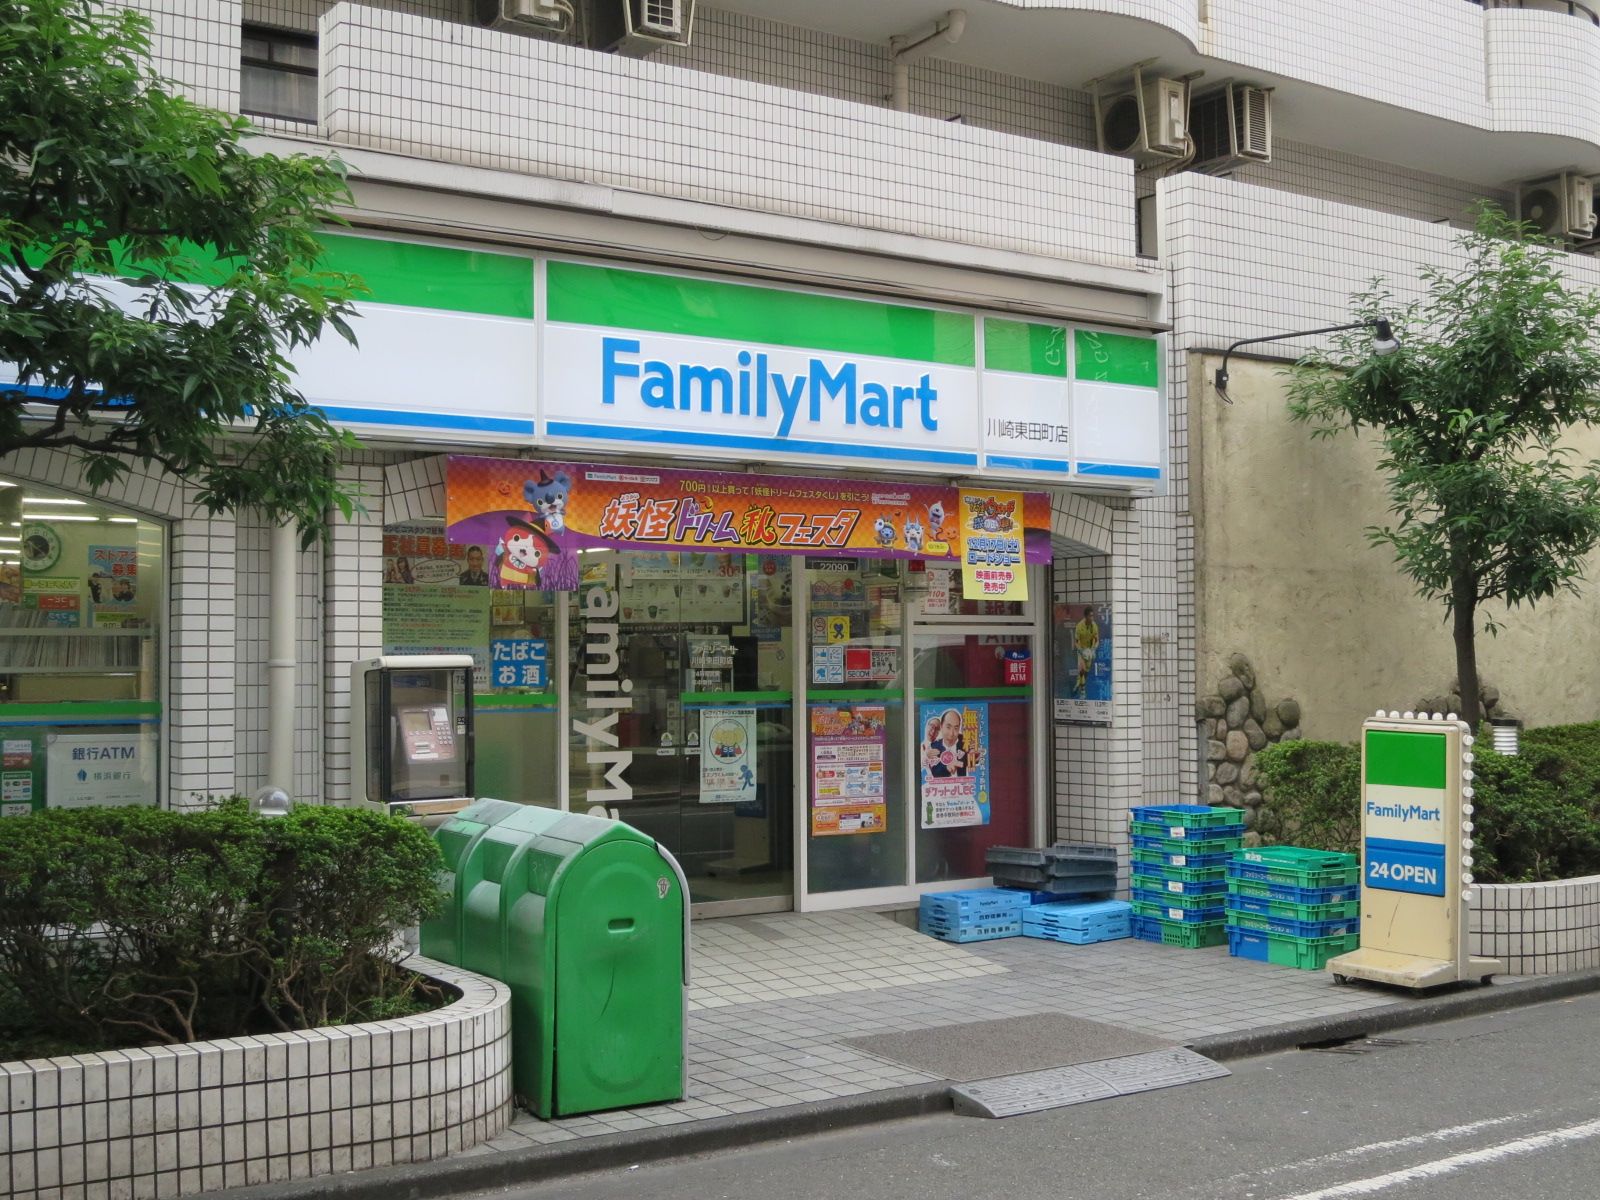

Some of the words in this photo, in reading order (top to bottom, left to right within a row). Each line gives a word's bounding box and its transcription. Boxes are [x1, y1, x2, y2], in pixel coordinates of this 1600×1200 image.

[602, 337, 938, 438] FamilyMart
[988, 418, 1068, 443] 川崎東田町店
[968, 551, 1020, 566] ロードショー
[976, 570, 1012, 581] 映画前売券
[983, 582, 1006, 592] 発売中
[494, 642, 545, 661] たばこ
[848, 670, 870, 678] SECOM
[1010, 662, 1026, 673] 銀行
[499, 665, 540, 685] お酒
[72, 747, 135, 760] 銀行ATM
[94, 772, 131, 781] 横浜銀行
[1367, 802, 1440, 822] FamilyMart
